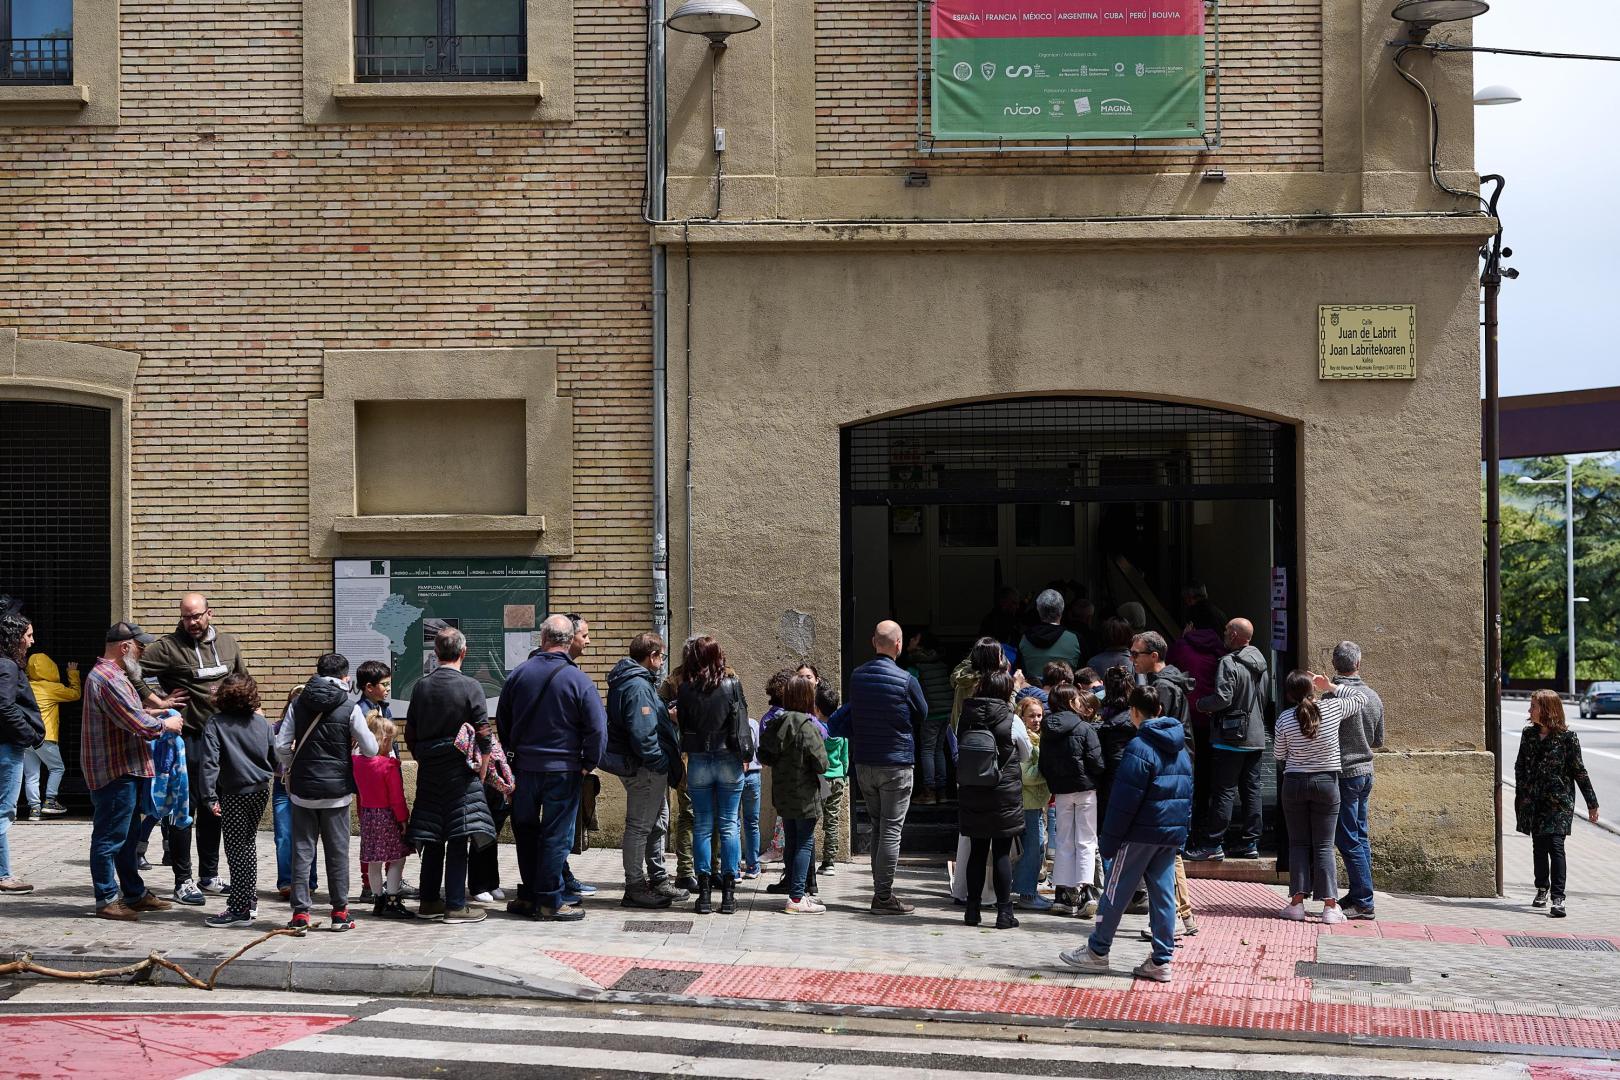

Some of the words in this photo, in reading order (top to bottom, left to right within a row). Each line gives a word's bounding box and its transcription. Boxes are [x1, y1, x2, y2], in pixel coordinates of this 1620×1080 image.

[952, 12, 980, 21] ESPAÑA
[985, 13, 1017, 21] FRANCIA
[1022, 11, 1052, 20] MÉXICO
[1057, 12, 1098, 20] ARGENTINA
[1129, 10, 1147, 19] PERÚ
[1152, 11, 1181, 19] BOLIVIA
[1338, 327, 1358, 339] Juan
[1360, 327, 1370, 339] de
[1373, 326, 1397, 339] Labrit
[1329, 344, 1348, 356] Joan
[1351, 343, 1406, 356] Labritekoaren
